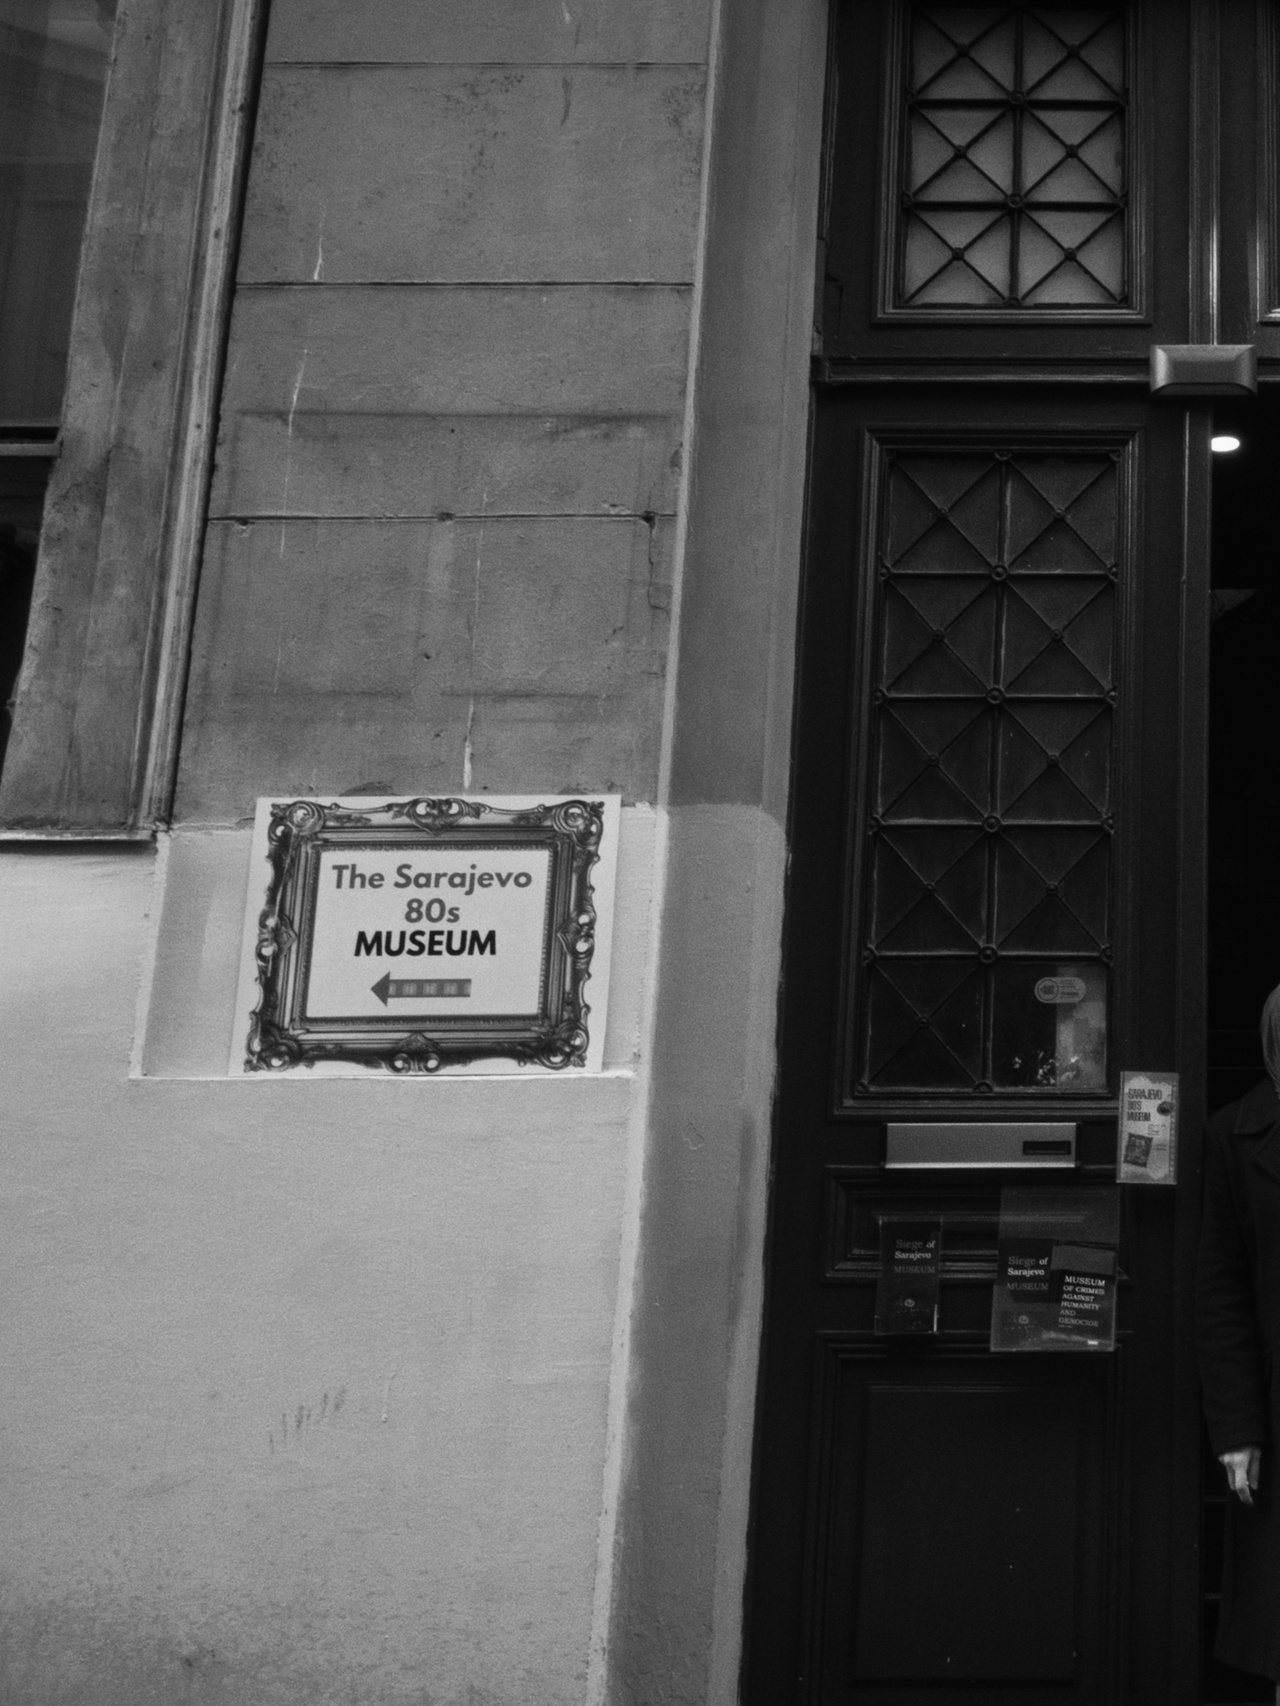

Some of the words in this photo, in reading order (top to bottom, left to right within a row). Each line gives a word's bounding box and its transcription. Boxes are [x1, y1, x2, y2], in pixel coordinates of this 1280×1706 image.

[332, 864, 385, 890] The
[393, 863, 533, 896] Sarajevo
[404, 898, 461, 924] 80s
[353, 929, 497, 957] MUSEUM
[1127, 1088, 1163, 1100] SARAJEVO
[1127, 1111, 1151, 1122] MUSEUM
[895, 1238, 924, 1250] Siege
[926, 1239, 936, 1249] of
[894, 1250, 932, 1261] Sarajevo
[1008, 1255, 1037, 1267] Siege
[1038, 1256, 1049, 1266] of
[893, 1265, 936, 1274] MUSEUM
[1007, 1267, 1045, 1278] Sarajevo
[1006, 1282, 1049, 1291] MUSEUM
[1064, 1275, 1106, 1287] MUSEUM
[1075, 1286, 1105, 1295] CRIMES
[1061, 1293, 1095, 1302] AGAINST
[1060, 1301, 1101, 1311] HUMANITY
[1058, 1316, 1099, 1327] GENOCIDE
